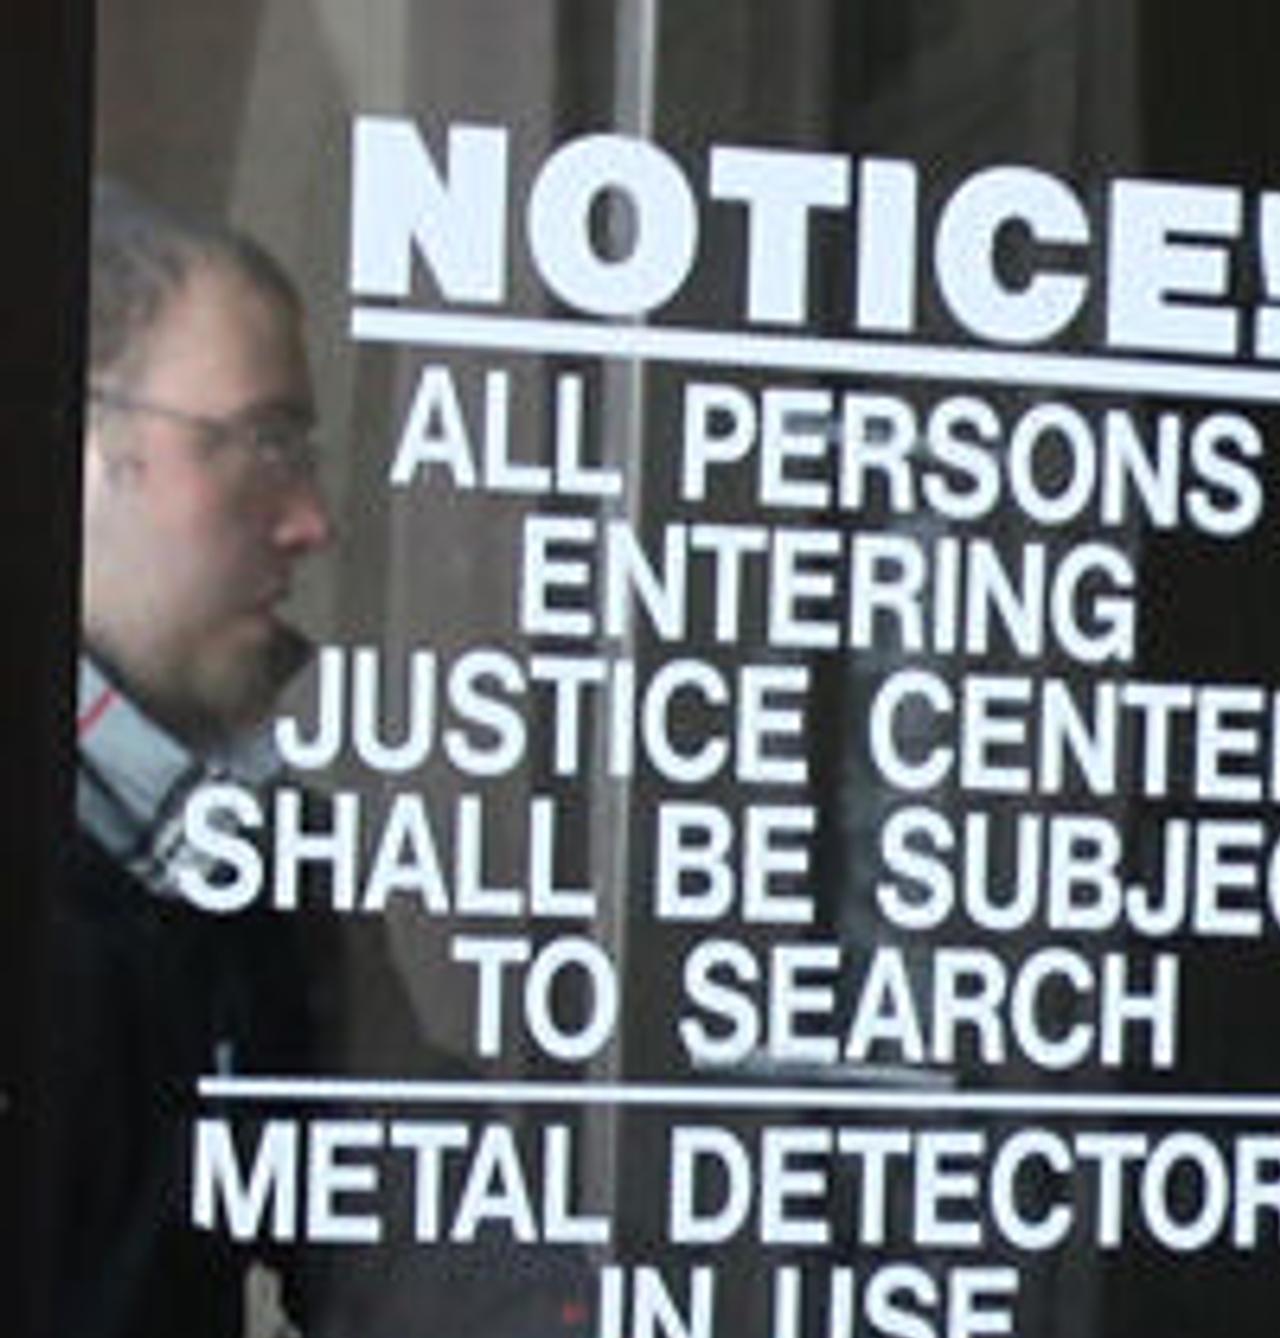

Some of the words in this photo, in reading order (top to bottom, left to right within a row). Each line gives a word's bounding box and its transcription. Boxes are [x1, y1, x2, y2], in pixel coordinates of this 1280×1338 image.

[389, 365, 625, 499] ALL
[682, 382, 1263, 534] PERSONS
[519, 514, 1135, 663] ENTERING
[273, 645, 811, 785] JUSTICE
[180, 785, 598, 918] SHALL
[655, 802, 817, 923] BE
[451, 935, 620, 1060] TO
[679, 939, 1179, 1069] SEARCH
[191, 1119, 612, 1244] METAL
